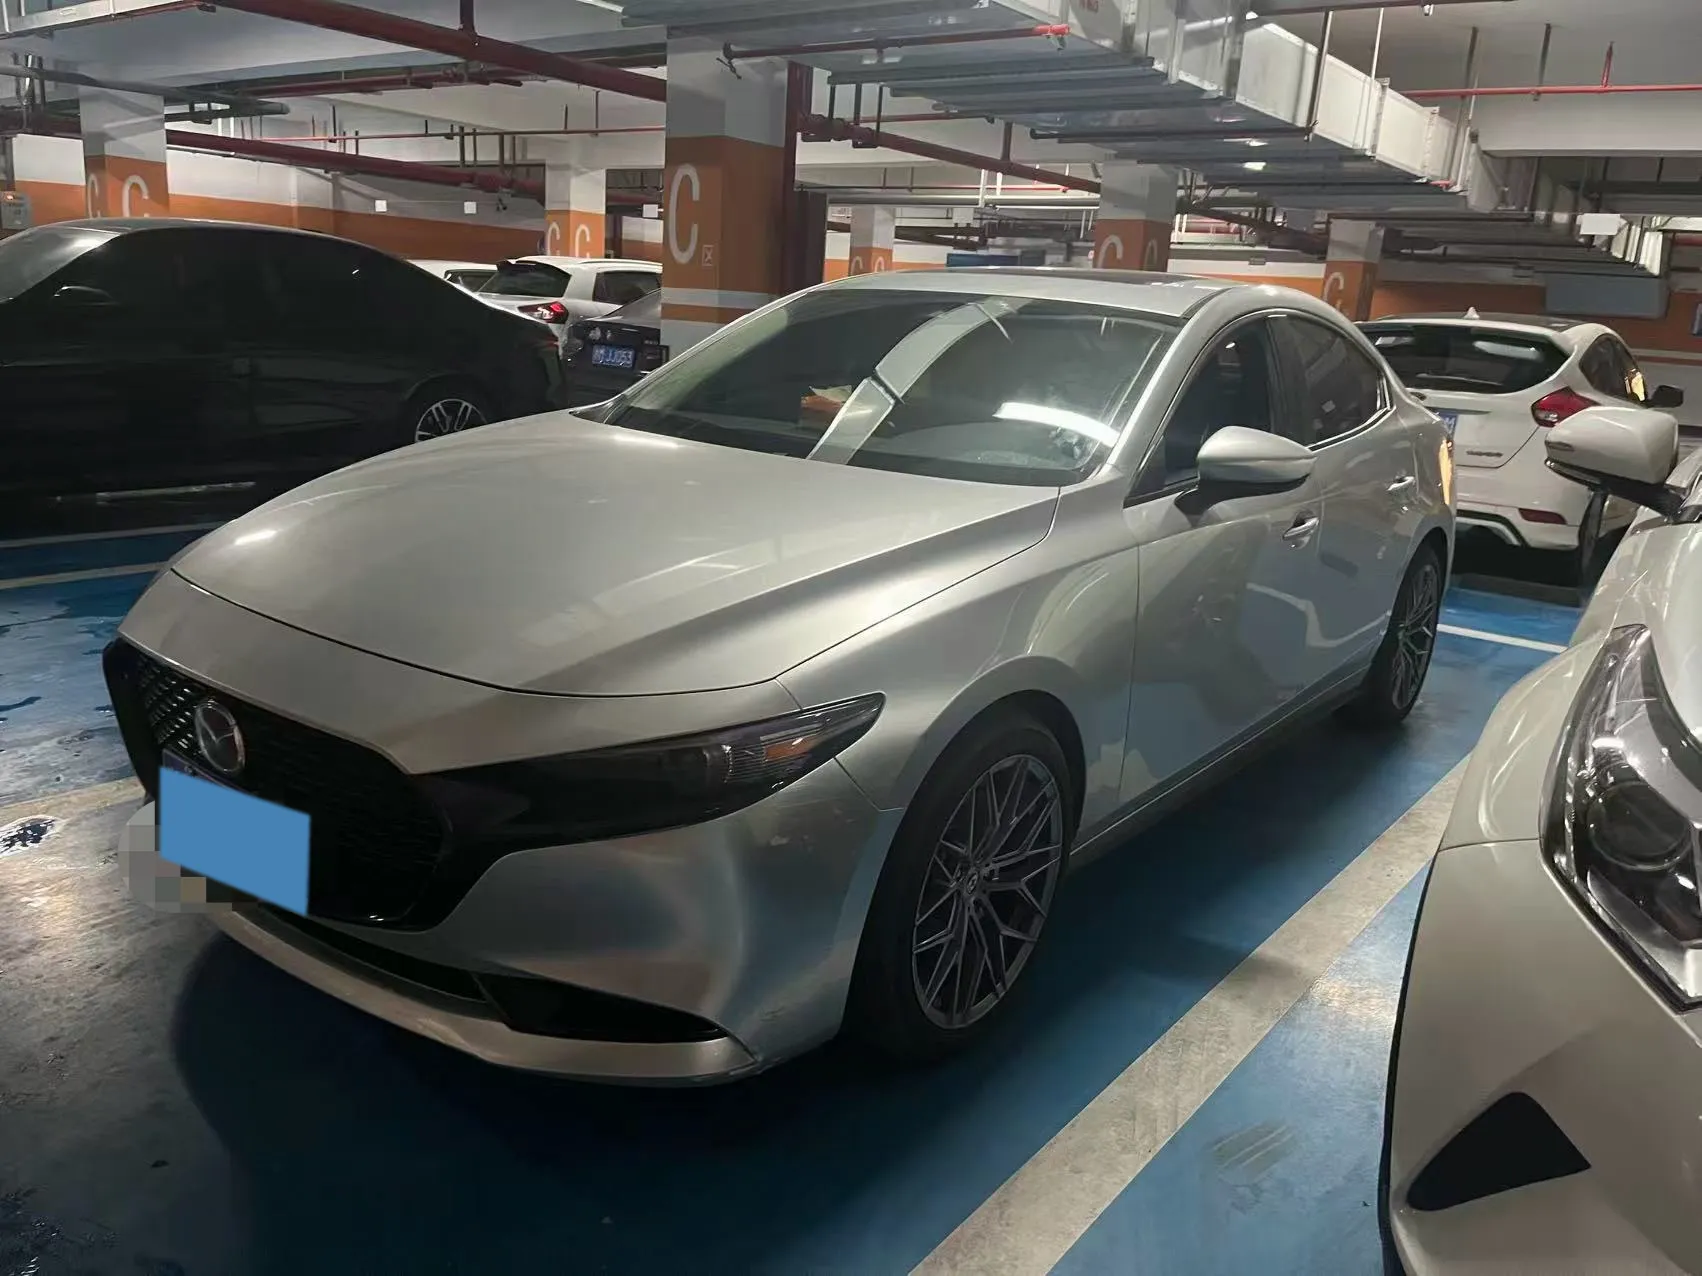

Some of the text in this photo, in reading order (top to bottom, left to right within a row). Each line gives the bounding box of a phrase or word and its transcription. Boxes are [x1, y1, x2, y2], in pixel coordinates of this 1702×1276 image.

[122, 175, 150, 217] C
[668, 164, 700, 264] C
[575, 224, 590, 258] C
